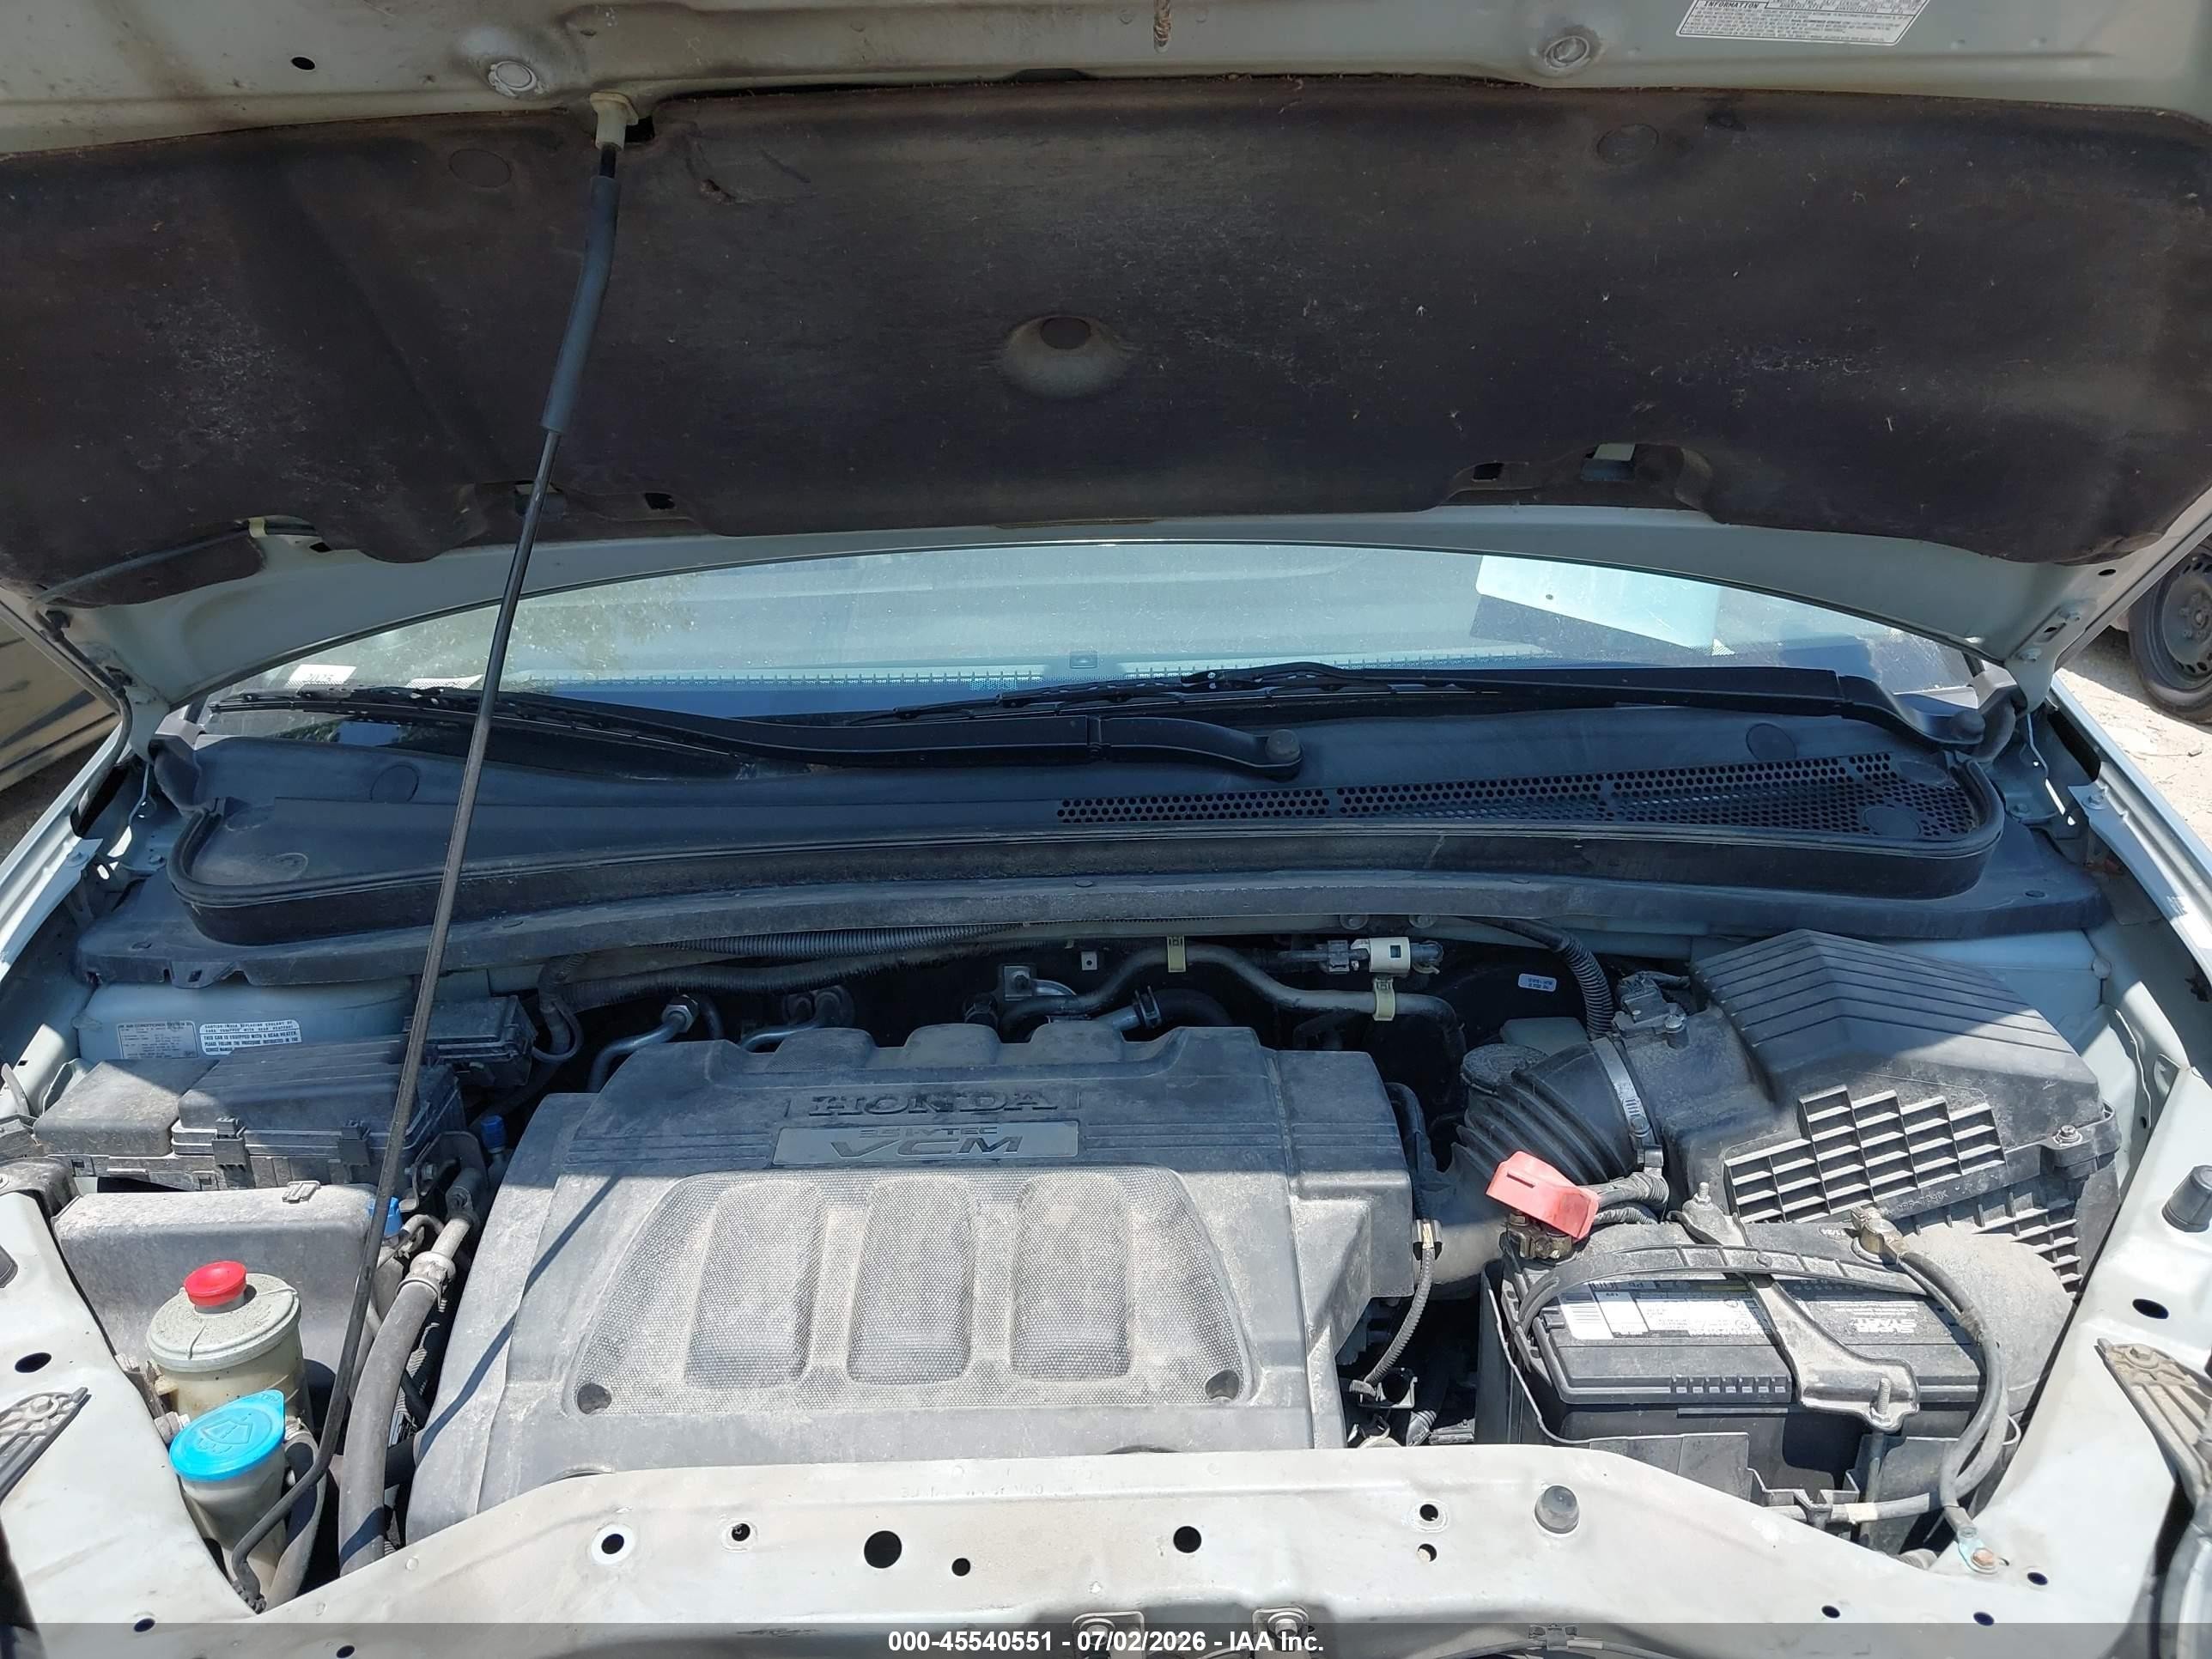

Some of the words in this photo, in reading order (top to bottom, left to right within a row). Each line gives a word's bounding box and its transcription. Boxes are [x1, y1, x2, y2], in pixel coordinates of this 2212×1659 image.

[809, 1091, 1058, 1115] HONDA
[830, 1135, 1024, 1158] VCM
[1852, 1317, 1917, 1327] START
[1856, 1325, 1915, 1334] SUPER
